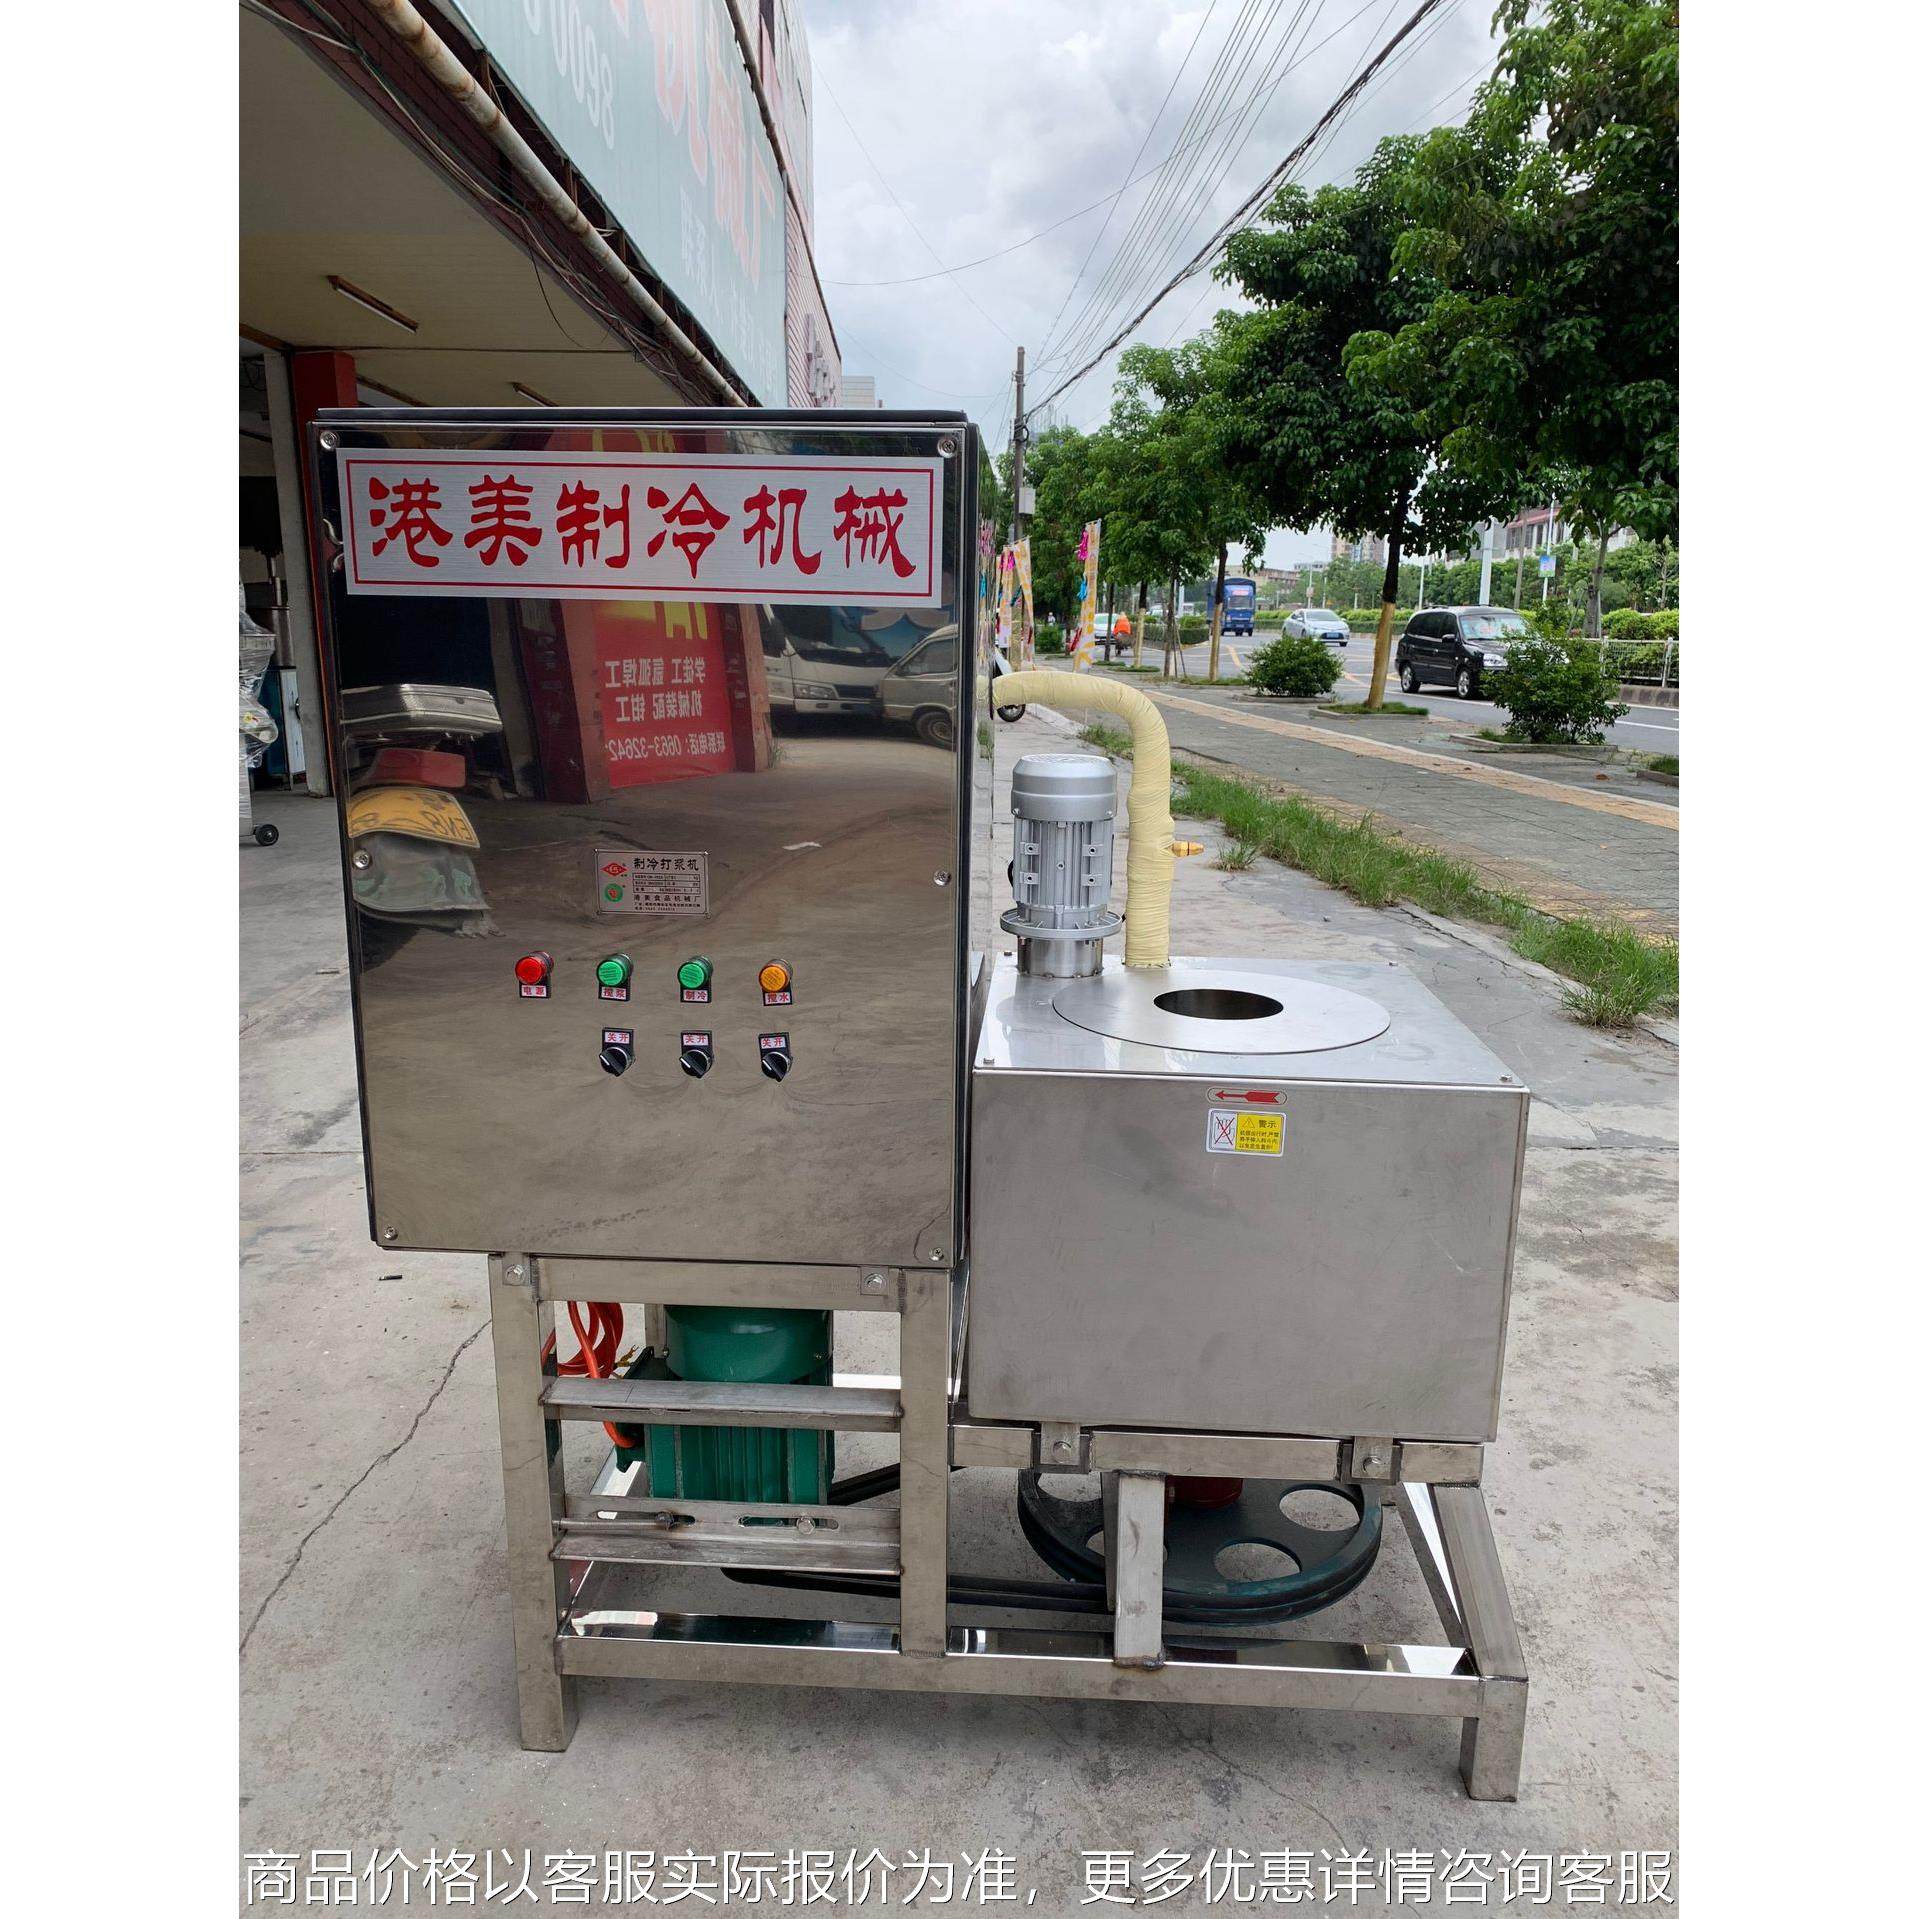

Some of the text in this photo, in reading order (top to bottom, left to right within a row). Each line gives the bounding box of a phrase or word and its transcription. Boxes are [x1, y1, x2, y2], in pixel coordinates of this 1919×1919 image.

[368, 474, 918, 579] 港美制冷机械
[633, 857, 699, 871] 制冷打浆机
[523, 986, 546, 997] 电源
[685, 990, 708, 1000] 制冷
[1259, 1120, 1277, 1129] 警示
